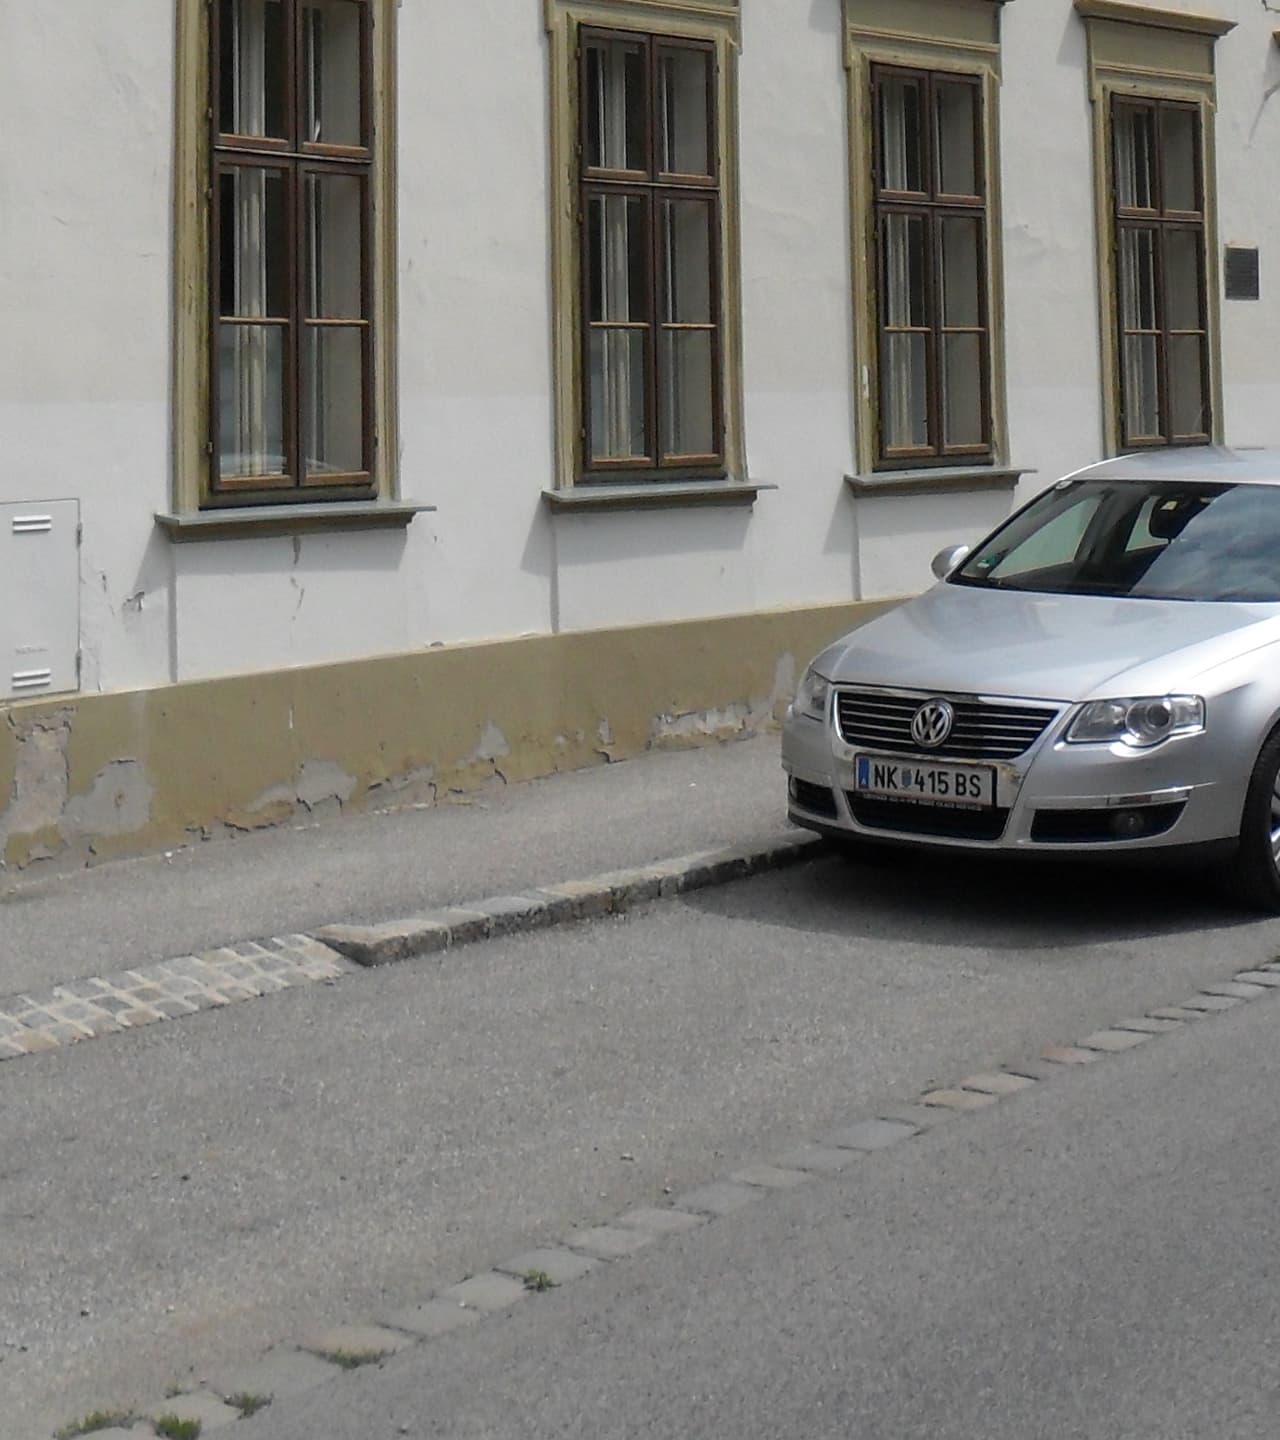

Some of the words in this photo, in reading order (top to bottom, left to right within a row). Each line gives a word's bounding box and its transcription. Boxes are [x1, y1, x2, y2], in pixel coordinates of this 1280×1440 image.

[874, 764, 898, 790] NK
[914, 768, 950, 795] 415
[955, 772, 981, 798] BS
